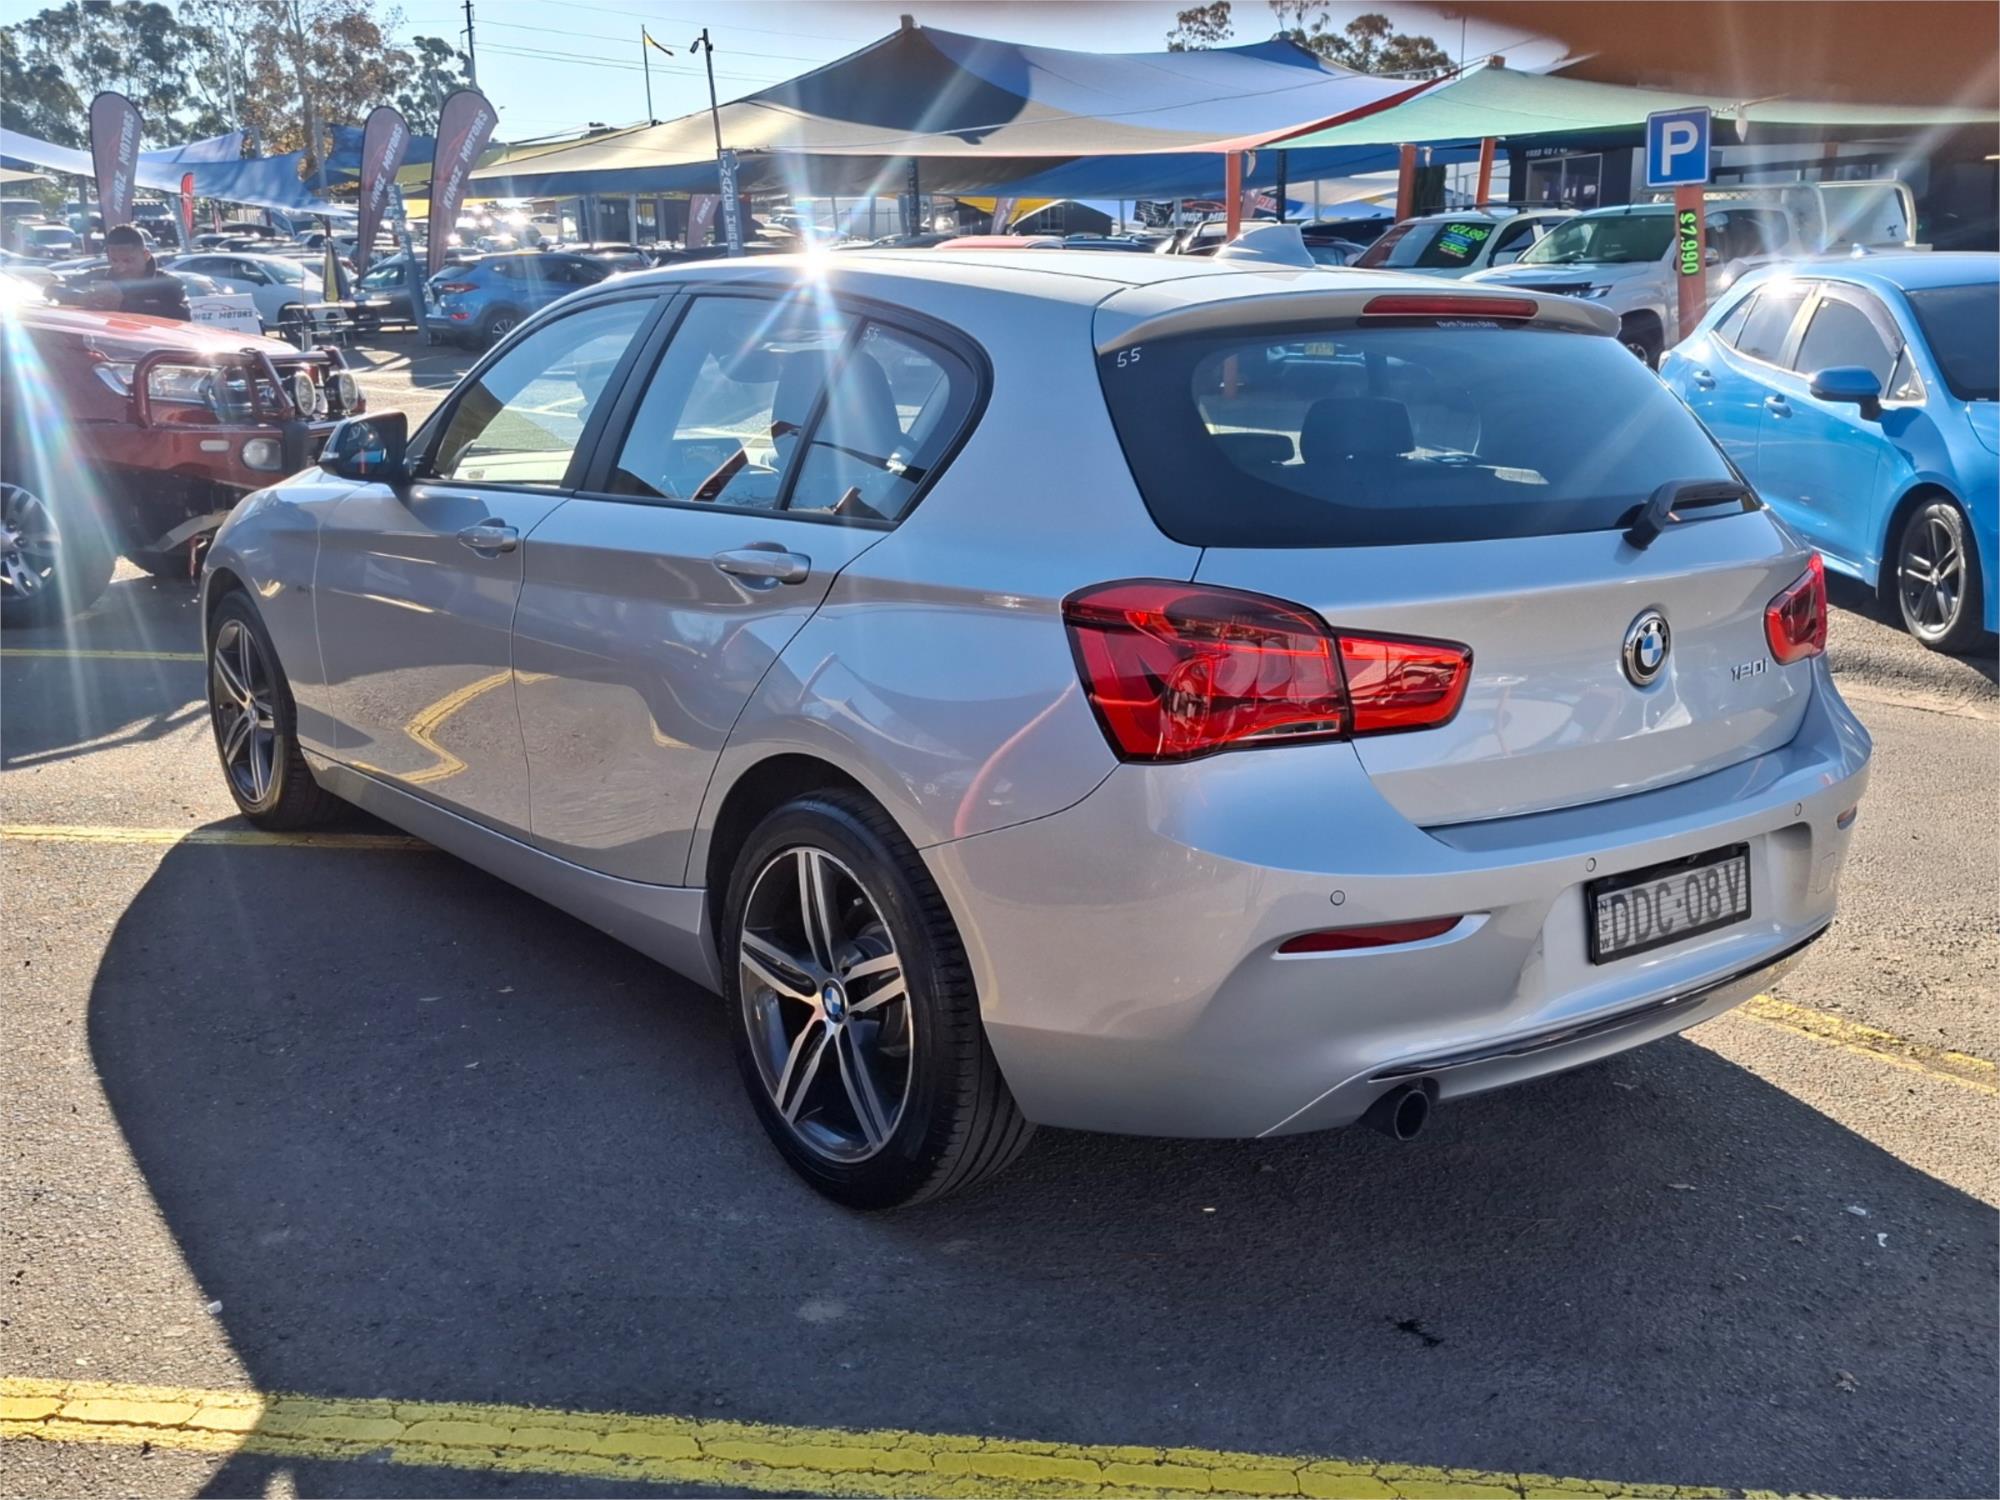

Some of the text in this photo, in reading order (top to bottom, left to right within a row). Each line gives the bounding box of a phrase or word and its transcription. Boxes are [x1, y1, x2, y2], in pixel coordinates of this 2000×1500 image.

[118, 110, 135, 166] MOTORS
[382, 123, 402, 170] MOTORS
[443, 109, 488, 209] KINGZ MOTORS
[1661, 120, 1699, 176] P
[720, 151, 738, 250] FINANCE HERE
[219, 310, 253, 320] MOTORS
[1116, 346, 1142, 368] 55
[1731, 657, 1769, 682] 120i
